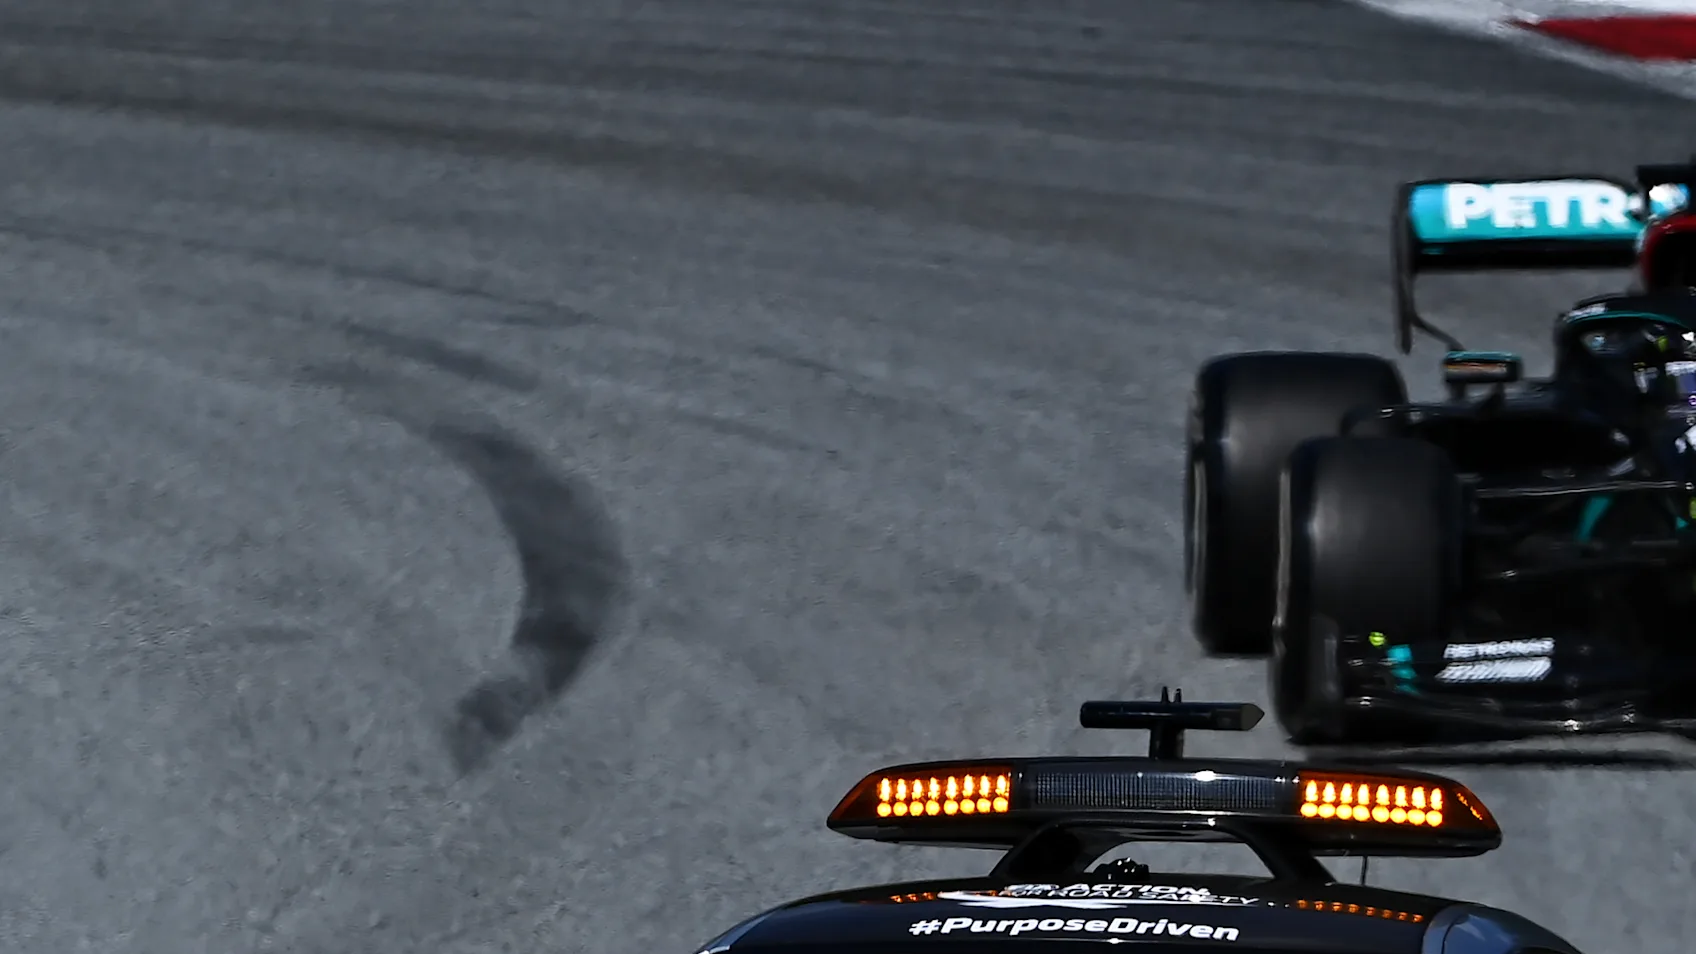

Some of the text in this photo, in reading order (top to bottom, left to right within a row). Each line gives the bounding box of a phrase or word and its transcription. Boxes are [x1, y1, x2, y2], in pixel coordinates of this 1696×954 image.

[1047, 888, 1134, 898] ROAD
[1063, 883, 1211, 896] ACTION
[909, 915, 1240, 942] #PurposeDriven
